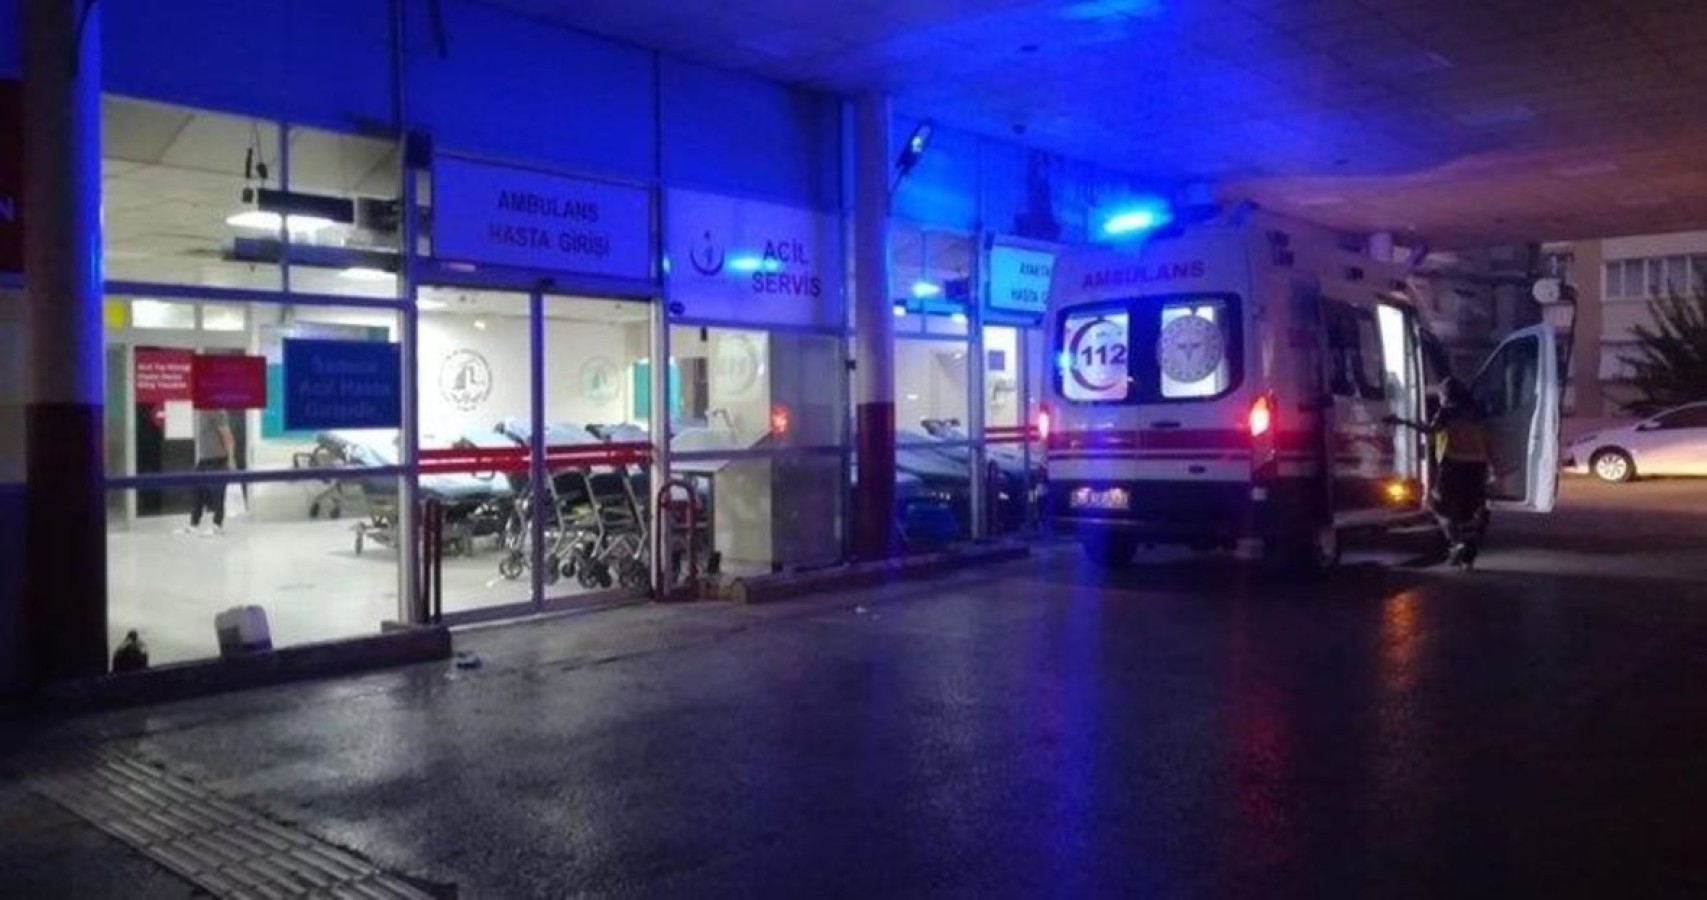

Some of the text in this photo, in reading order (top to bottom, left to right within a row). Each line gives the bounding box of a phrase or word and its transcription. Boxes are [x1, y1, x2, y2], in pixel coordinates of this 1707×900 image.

[498, 189, 600, 223] AMBULANS
[489, 224, 551, 247] HASTA
[752, 270, 822, 298] SERVİS
[1082, 259, 1205, 290] AMBULANS
[1081, 343, 1126, 366] 112
